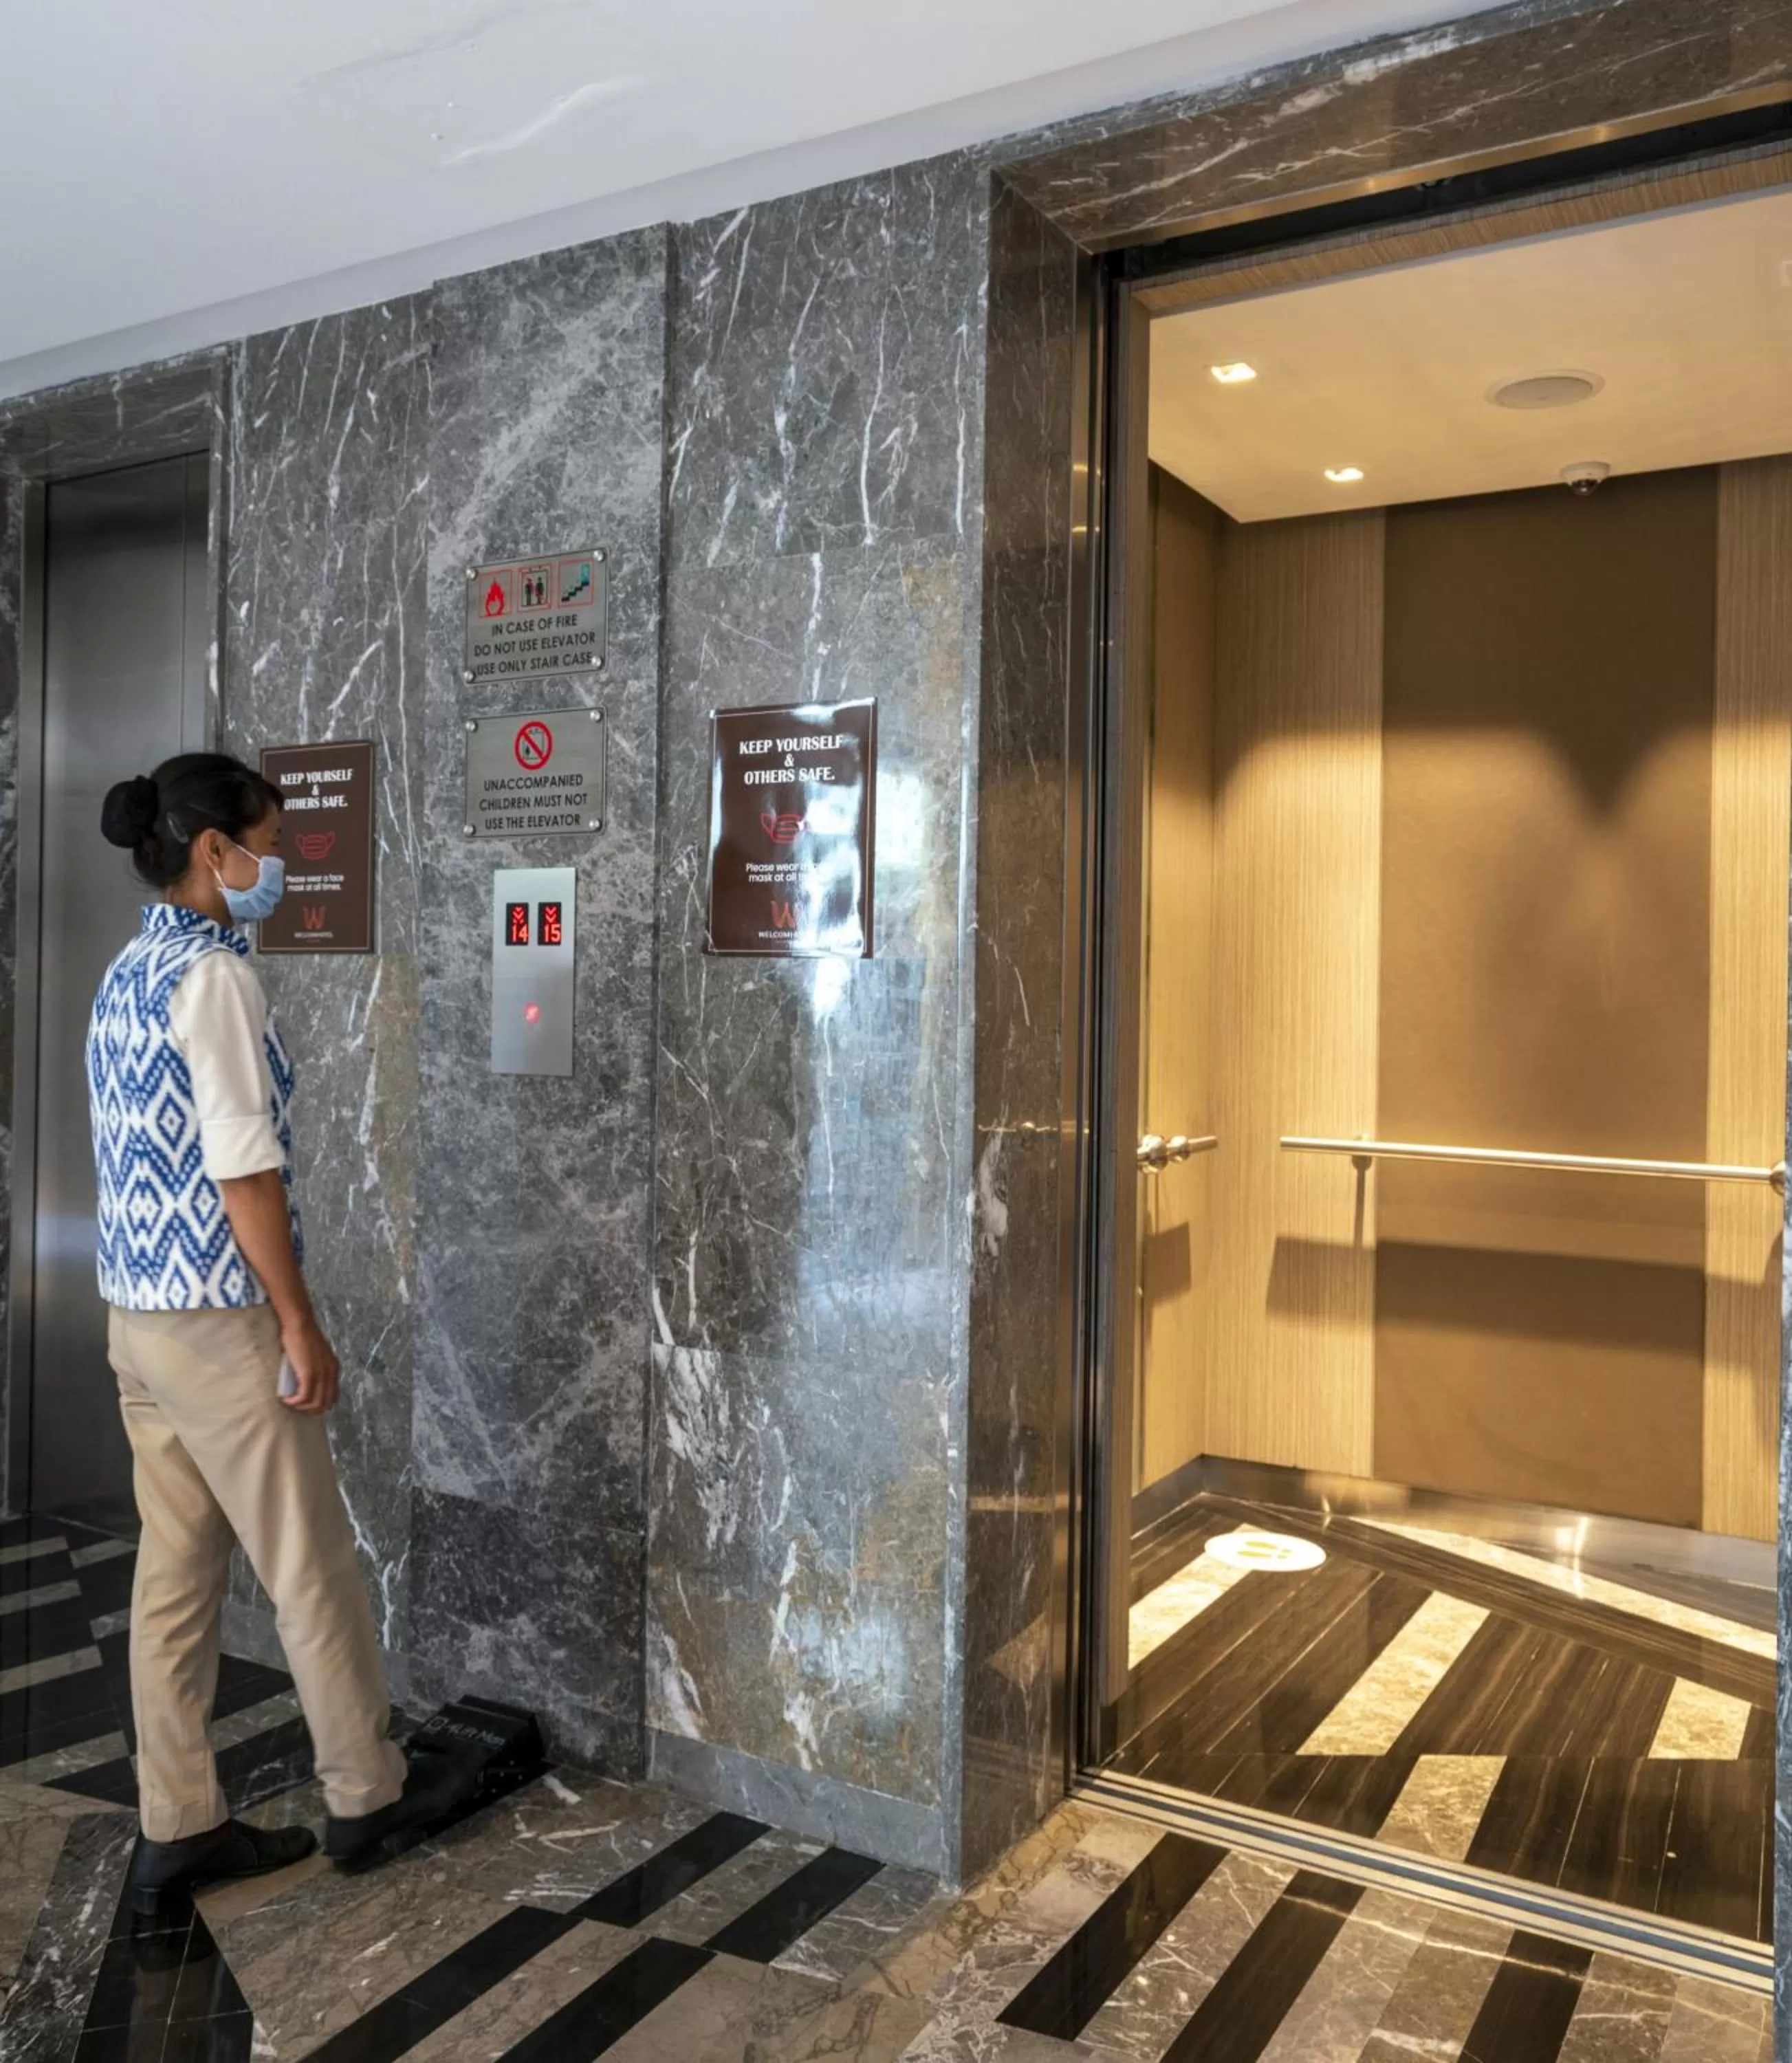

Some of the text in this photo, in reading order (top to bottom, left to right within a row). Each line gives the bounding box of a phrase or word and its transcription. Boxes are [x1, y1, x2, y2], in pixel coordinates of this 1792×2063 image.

[492, 614, 578, 637] IN CASE OF FIRE
[474, 632, 595, 657] DO NOT USE ELEVATOR
[476, 651, 592, 676] USE ONLY STAIR CASE
[739, 734, 844, 755] KEEP YOURSELF
[784, 753, 795, 767] &
[281, 768, 353, 785] KEEP YOURSELF
[483, 774, 583, 792] UNACCOMPANIED
[744, 767, 836, 785] OTHERS SAFE.
[311, 784, 320, 796] &
[283, 795, 349, 811] OTHERS SAFE.
[479, 793, 588, 811] CHILDREN MUST NOT
[485, 814, 581, 831] USE THE ELEVATOR
[745, 862, 774, 873] Please
[776, 863, 800, 872] wear
[748, 872, 772, 883] mask
[774, 872, 785, 882] at
[785, 872, 797, 882] all
[511, 924, 529, 943] 14
[544, 924, 561, 943] 15
